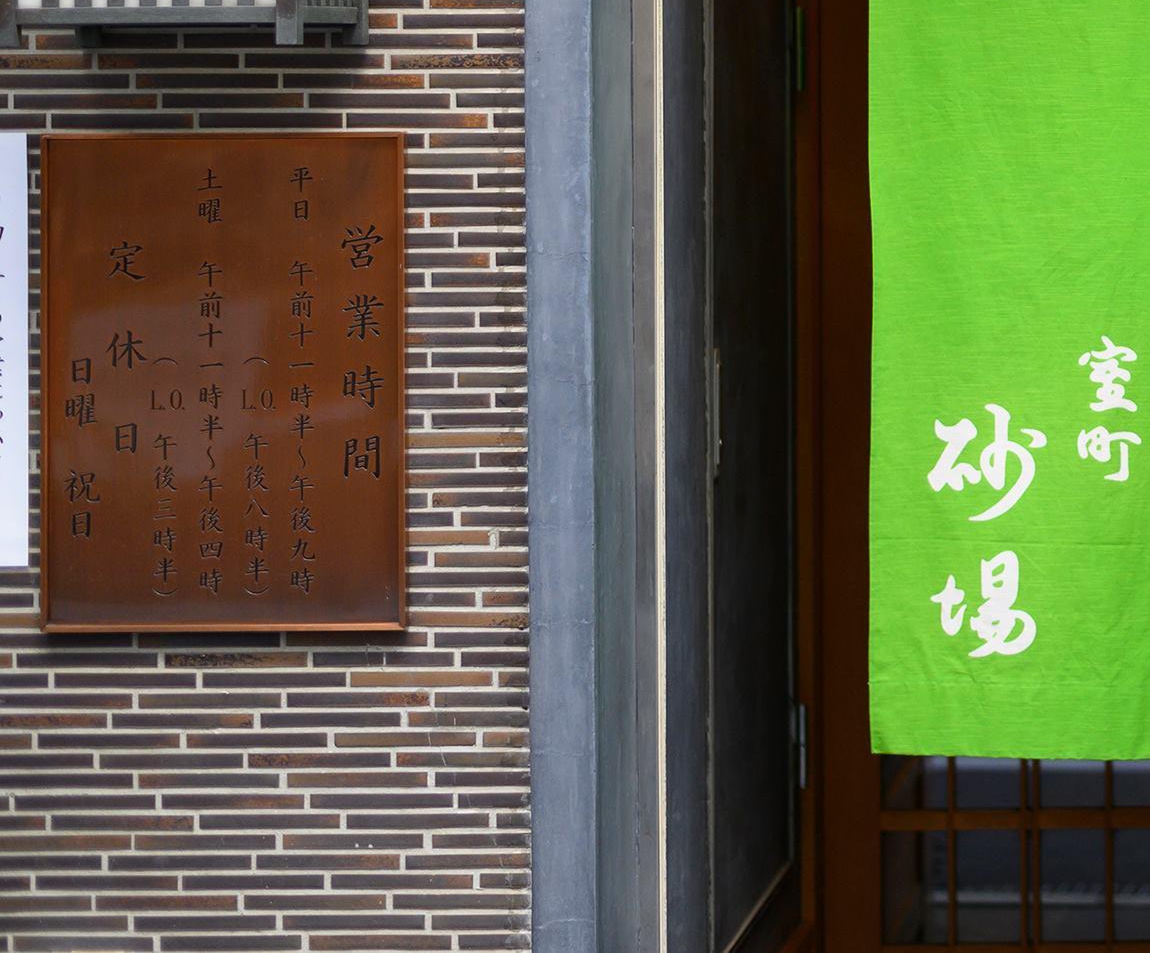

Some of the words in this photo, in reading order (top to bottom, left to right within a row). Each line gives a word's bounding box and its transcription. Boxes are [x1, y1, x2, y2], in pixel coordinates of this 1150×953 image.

[197, 167, 224, 224] 土曜
[289, 166, 315, 221] 平日
[64, 356, 98, 429] 日曜
[105, 241, 147, 454] 定休日
[340, 224, 385, 479] 営業時間
[1076, 335, 1142, 483] 室町
[63, 468, 101, 539] 祝日
[926, 403, 1048, 658] 砂場
